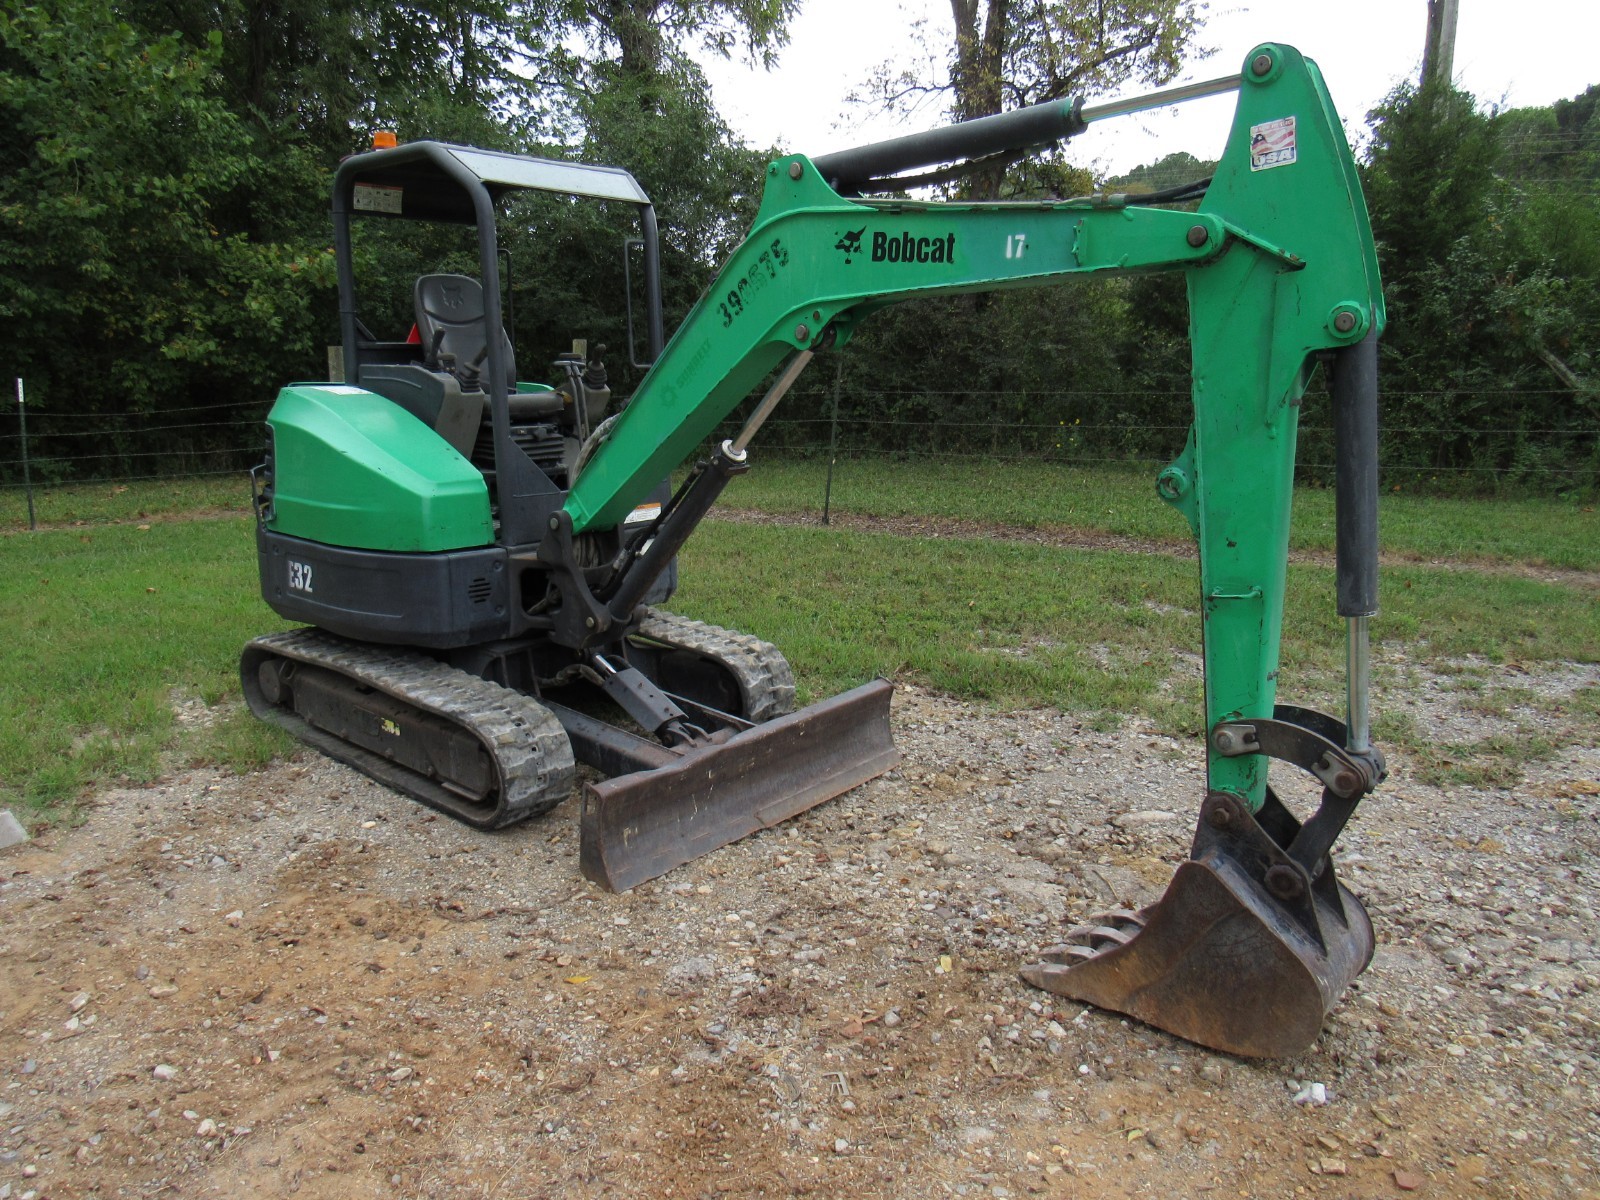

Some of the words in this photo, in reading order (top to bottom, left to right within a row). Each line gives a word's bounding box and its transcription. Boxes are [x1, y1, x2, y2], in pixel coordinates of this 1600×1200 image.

[1253, 149, 1293, 167] USA
[872, 231, 956, 264] Bobcat
[1006, 234, 1026, 259] 17
[288, 560, 314, 593] E32
